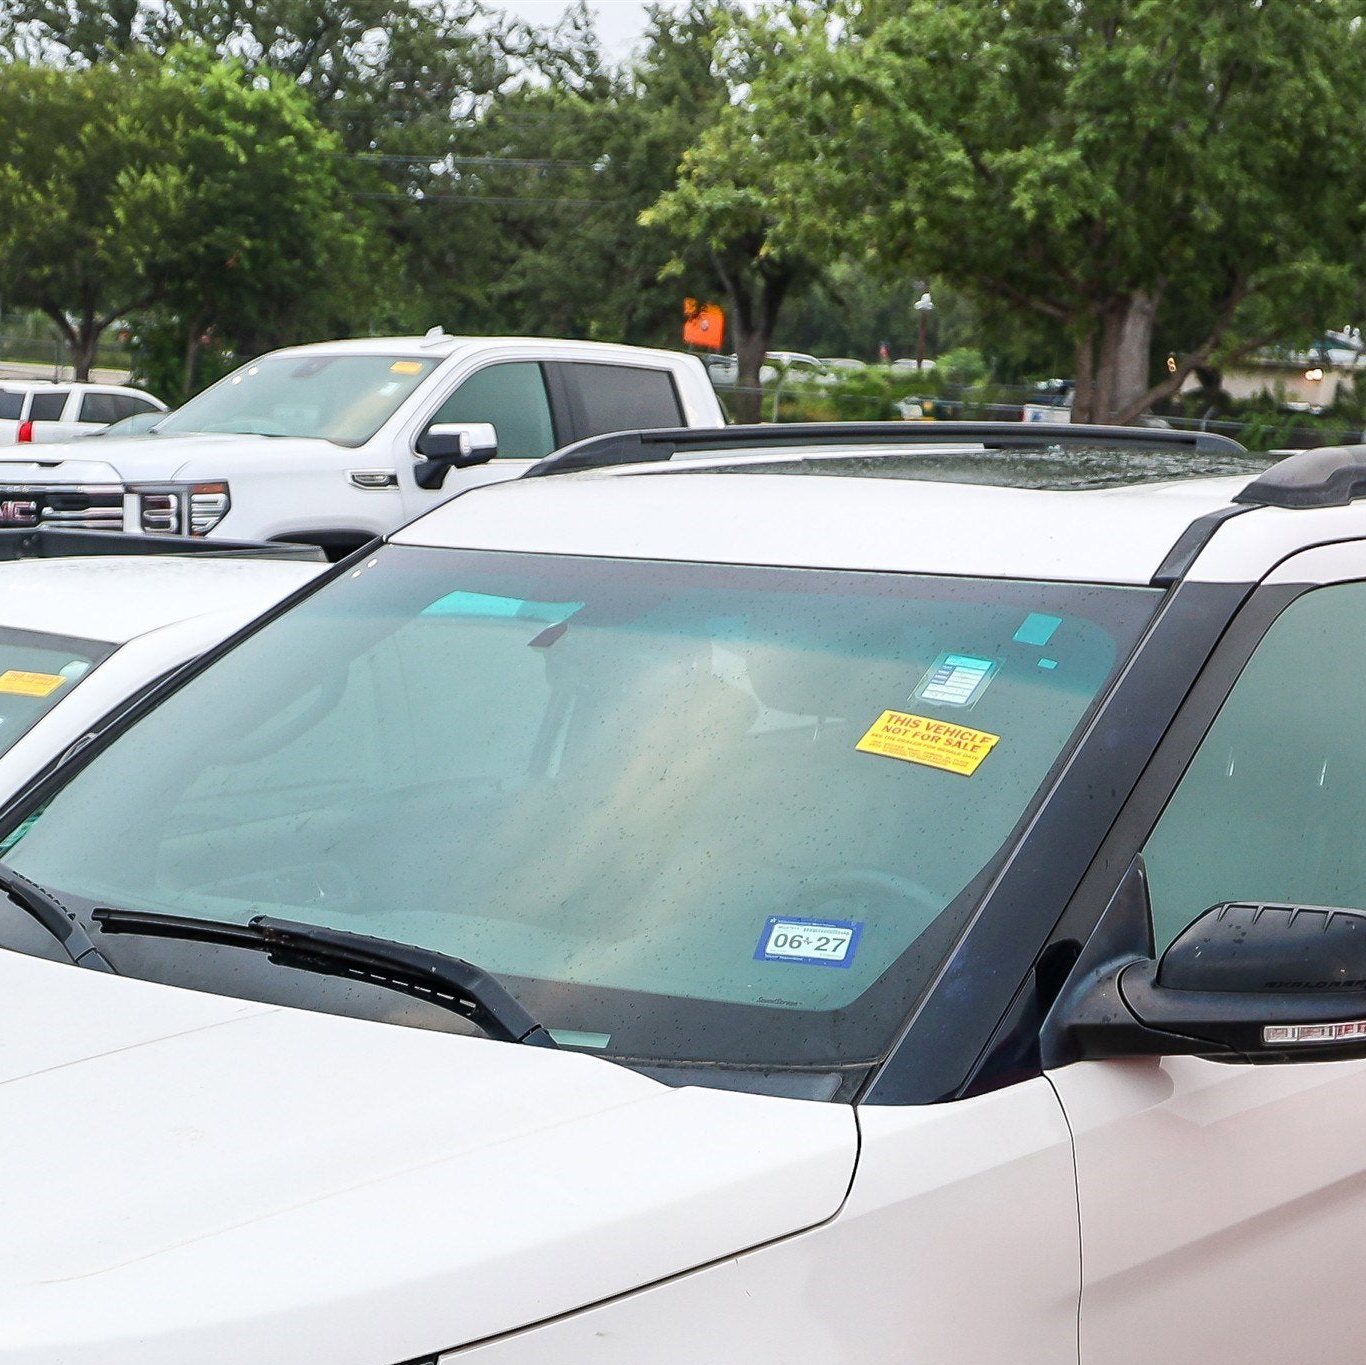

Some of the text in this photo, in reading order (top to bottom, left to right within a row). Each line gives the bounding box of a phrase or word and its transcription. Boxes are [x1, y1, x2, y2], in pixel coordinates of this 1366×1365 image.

[882, 725, 981, 753] NOT FOR SALE
[886, 714, 991, 743] THIS VEHICLE
[773, 933, 847, 953] 06 27
